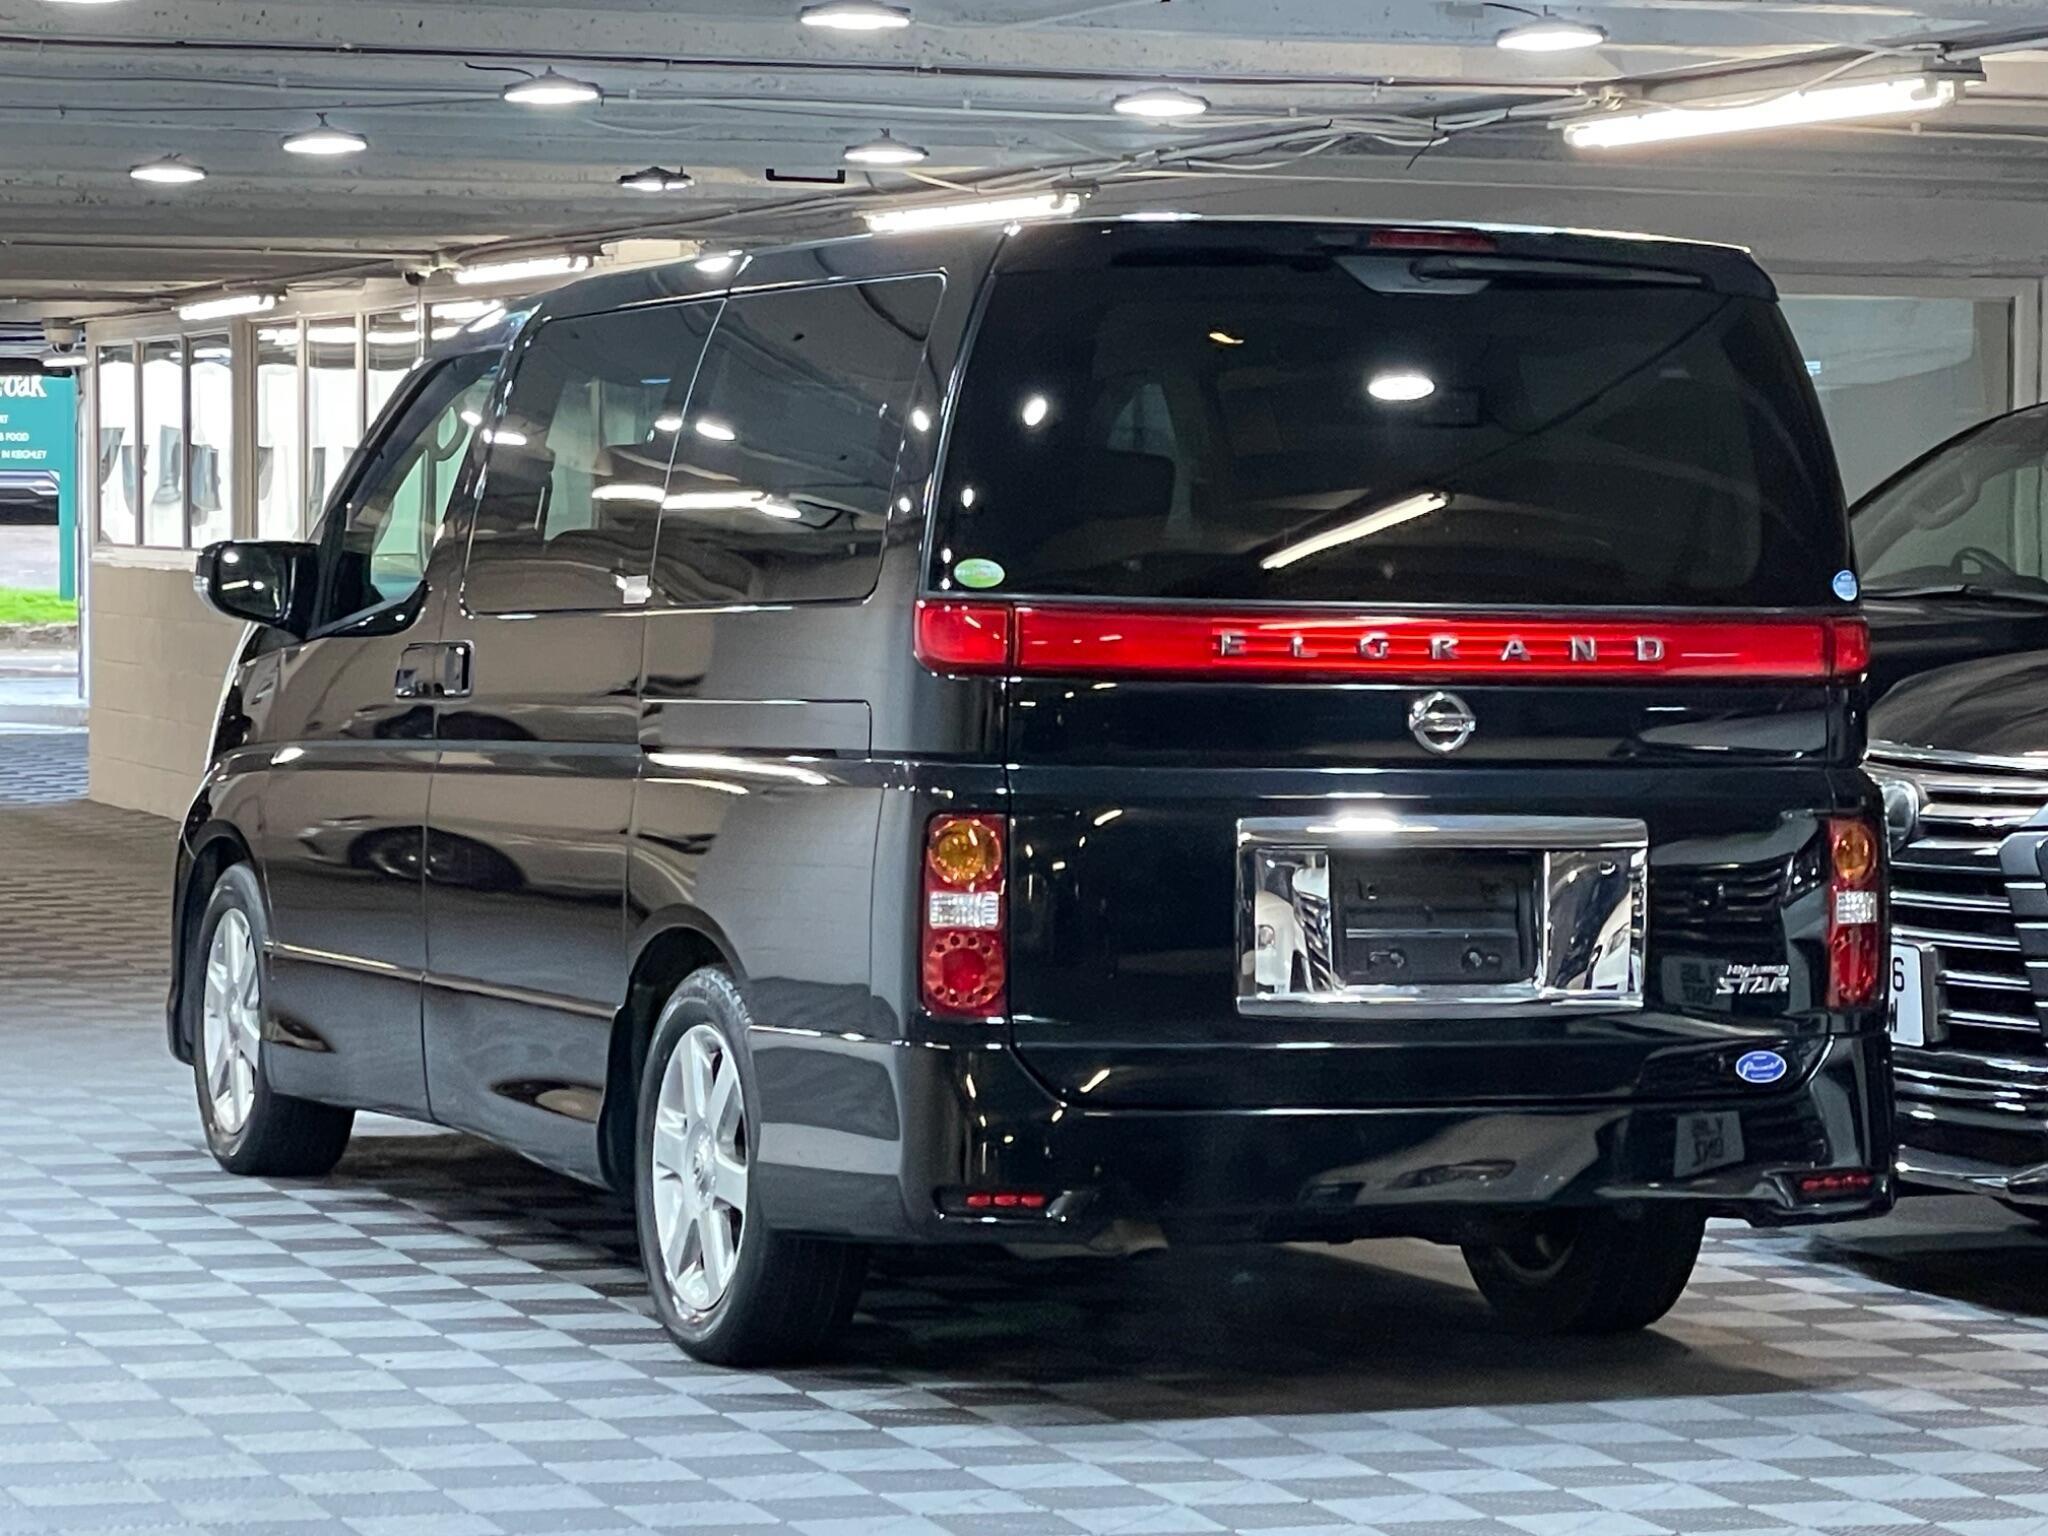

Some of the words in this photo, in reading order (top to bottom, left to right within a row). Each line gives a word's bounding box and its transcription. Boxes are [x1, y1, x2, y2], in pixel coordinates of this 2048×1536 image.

[5, 432, 30, 442] FOOD
[1219, 632, 1667, 662] ELGRAND
[1715, 976, 1790, 995] STAR
